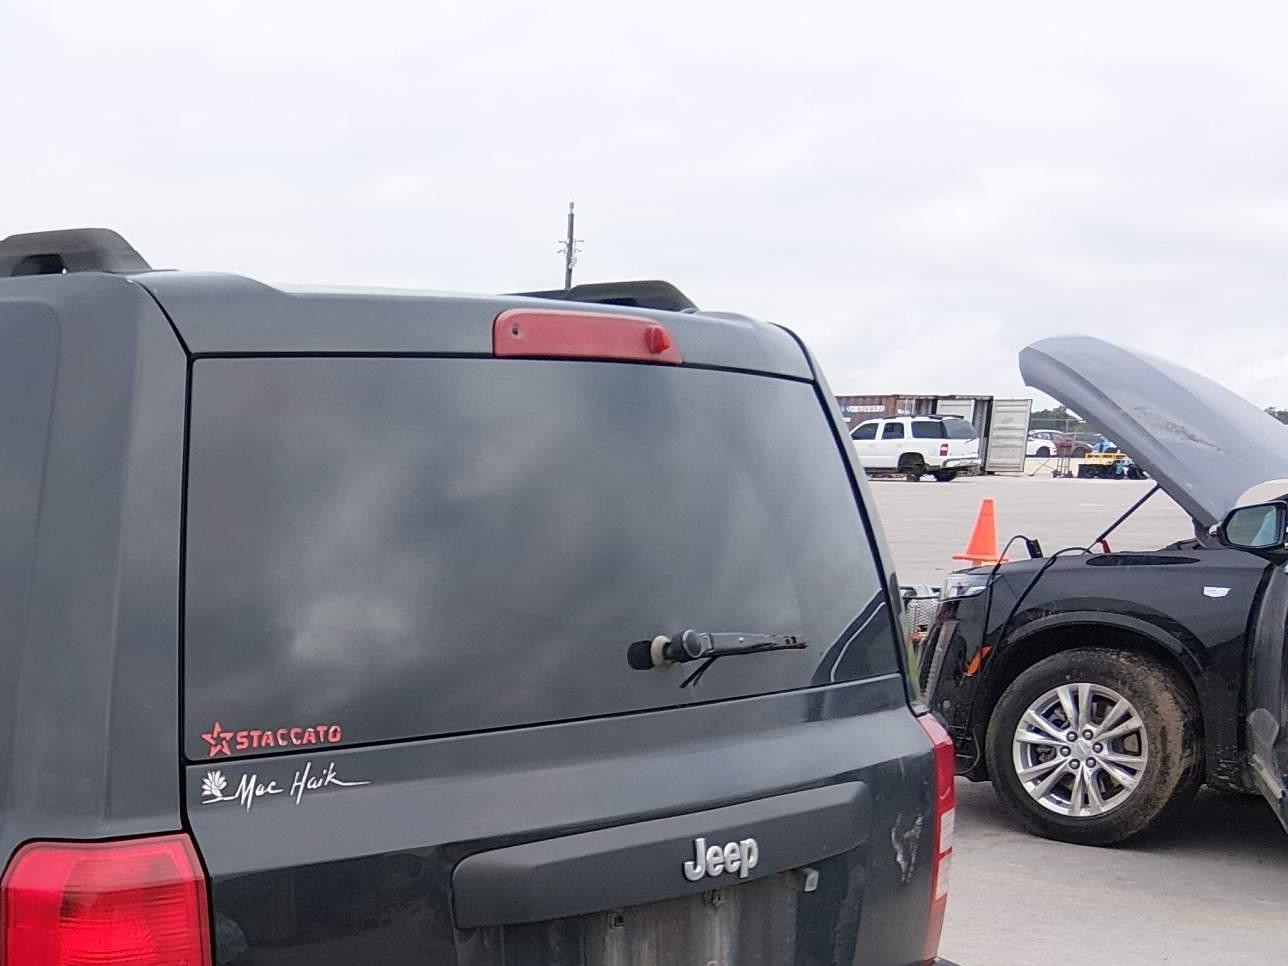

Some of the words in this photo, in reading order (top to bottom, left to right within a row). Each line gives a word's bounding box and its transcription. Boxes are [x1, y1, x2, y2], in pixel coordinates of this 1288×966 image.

[235, 725, 342, 750] STACCATO
[235, 773, 284, 812] Mac
[290, 761, 371, 804] Haik
[682, 837, 758, 881] Jeep
